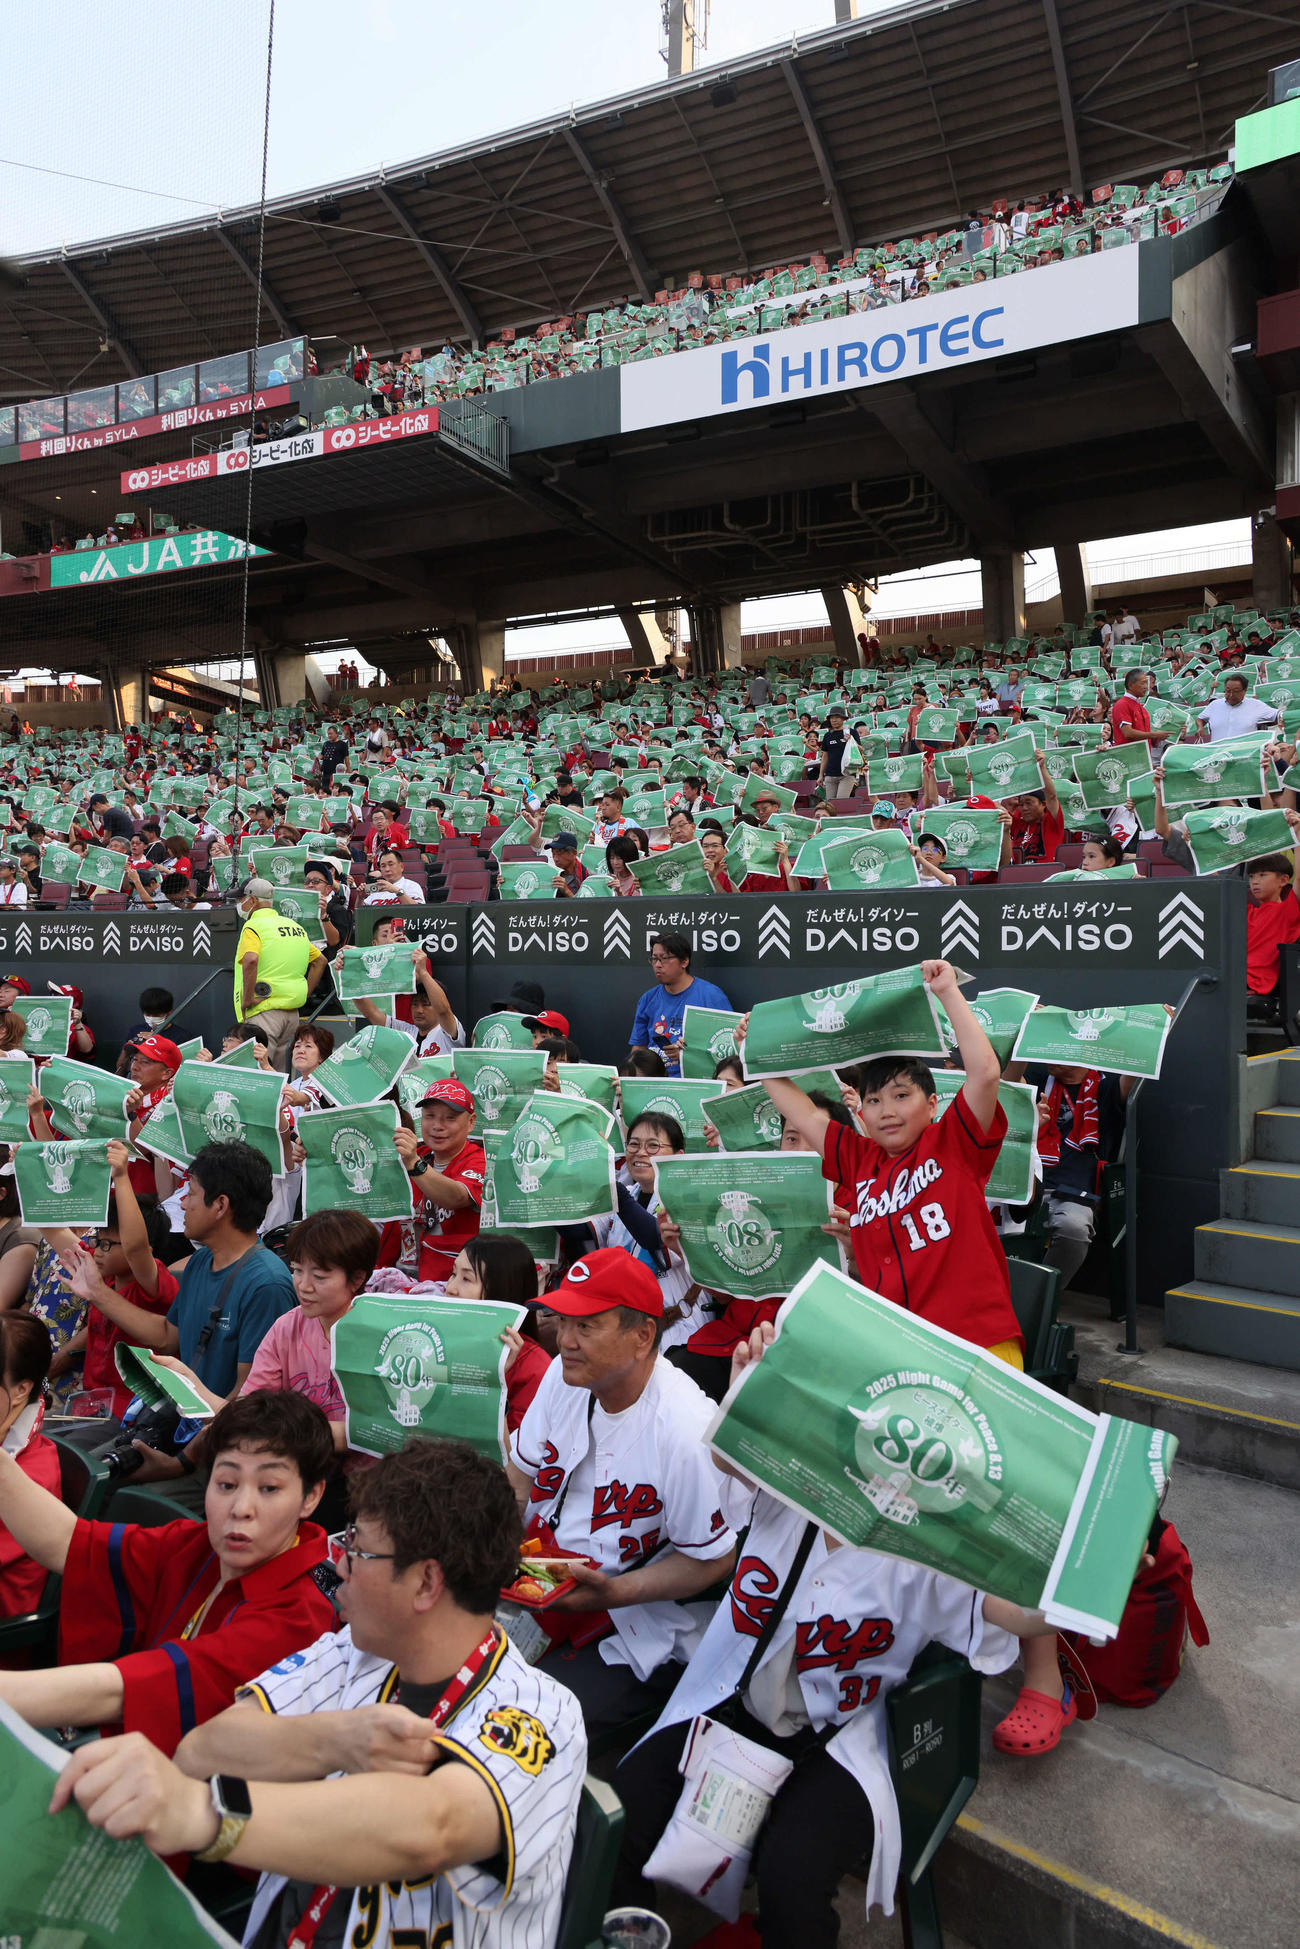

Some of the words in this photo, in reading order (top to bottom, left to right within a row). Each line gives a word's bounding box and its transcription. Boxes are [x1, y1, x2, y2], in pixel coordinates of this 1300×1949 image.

[781, 306, 1004, 393] HIROTEC
[161, 411, 214, 431] 利回りくん
[229, 397, 266, 415] SYLA
[40, 437, 91, 457] 利回りくん
[105, 427, 138, 444] SYLA
[859, 858, 877, 873] 80
[40, 937, 94, 951] DAISO
[130, 937, 184, 951] DAISO
[508, 932, 589, 952] DAISO
[646, 930, 741, 952] DISO
[806, 927, 920, 951] DAISO
[1001, 924, 1133, 950] DAISO
[901, 1202, 951, 1252] 18
[866, 1374, 897, 1399] 2025
[897, 1371, 930, 1385] Night
[932, 1374, 964, 1400] Game
[962, 1395, 979, 1416] for
[974, 1413, 998, 1451] Peace
[988, 1454, 1003, 1480] 8.13
[838, 1676, 882, 1713] 31
